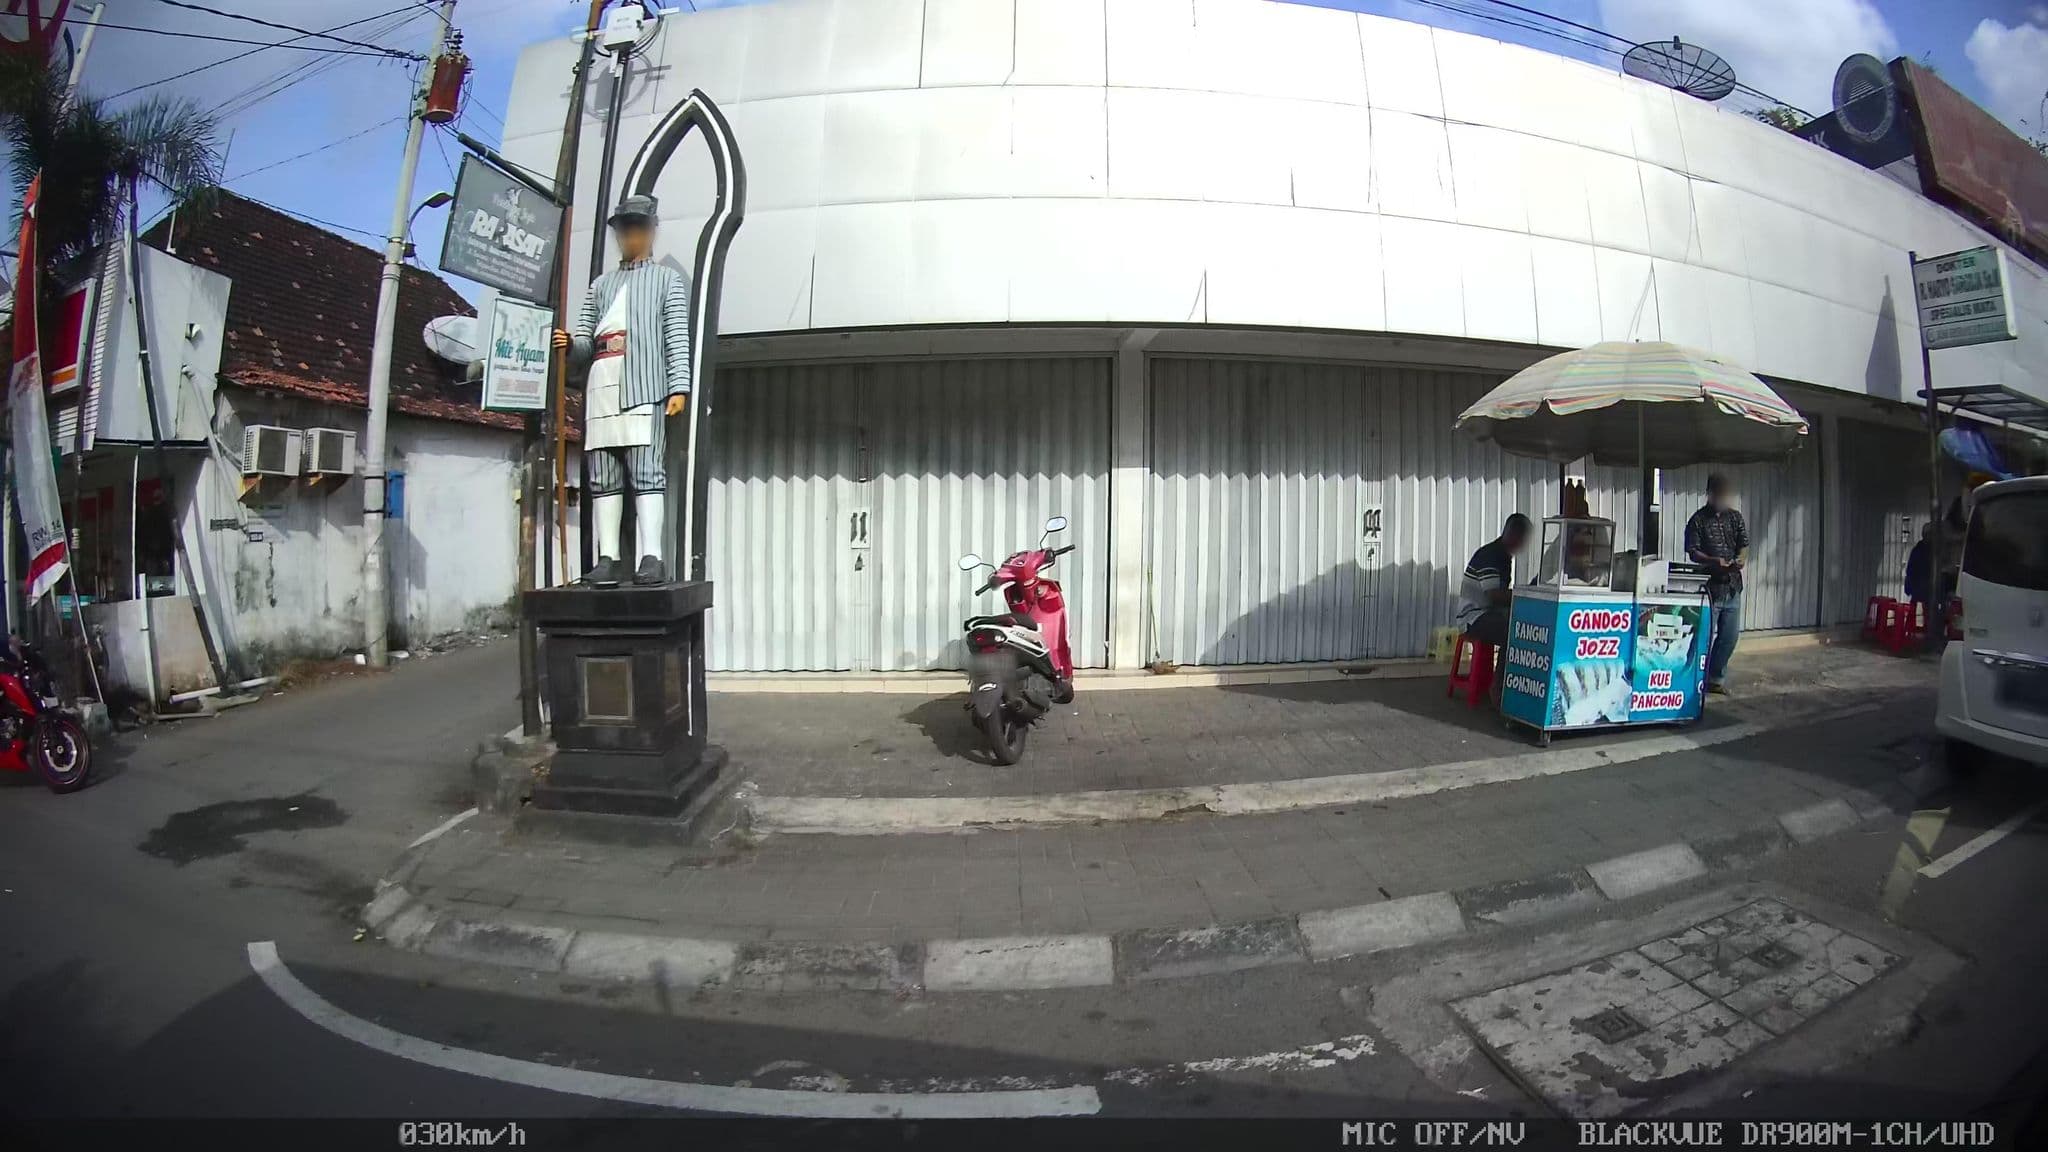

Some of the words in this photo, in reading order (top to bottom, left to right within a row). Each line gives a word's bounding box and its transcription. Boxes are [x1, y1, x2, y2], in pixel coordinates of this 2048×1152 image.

[495, 338, 513, 359] Mie
[516, 343, 545, 366] Ayam
[1570, 610, 1631, 631] GANDOS
[1515, 621, 1549, 644] RANGIN
[1508, 646, 1549, 671] BANDROS
[1577, 638, 1619, 658] JOZZ
[1505, 673, 1546, 698] GONJING
[1649, 671, 1672, 688] KUE
[1631, 692, 1683, 710] PANCONG
